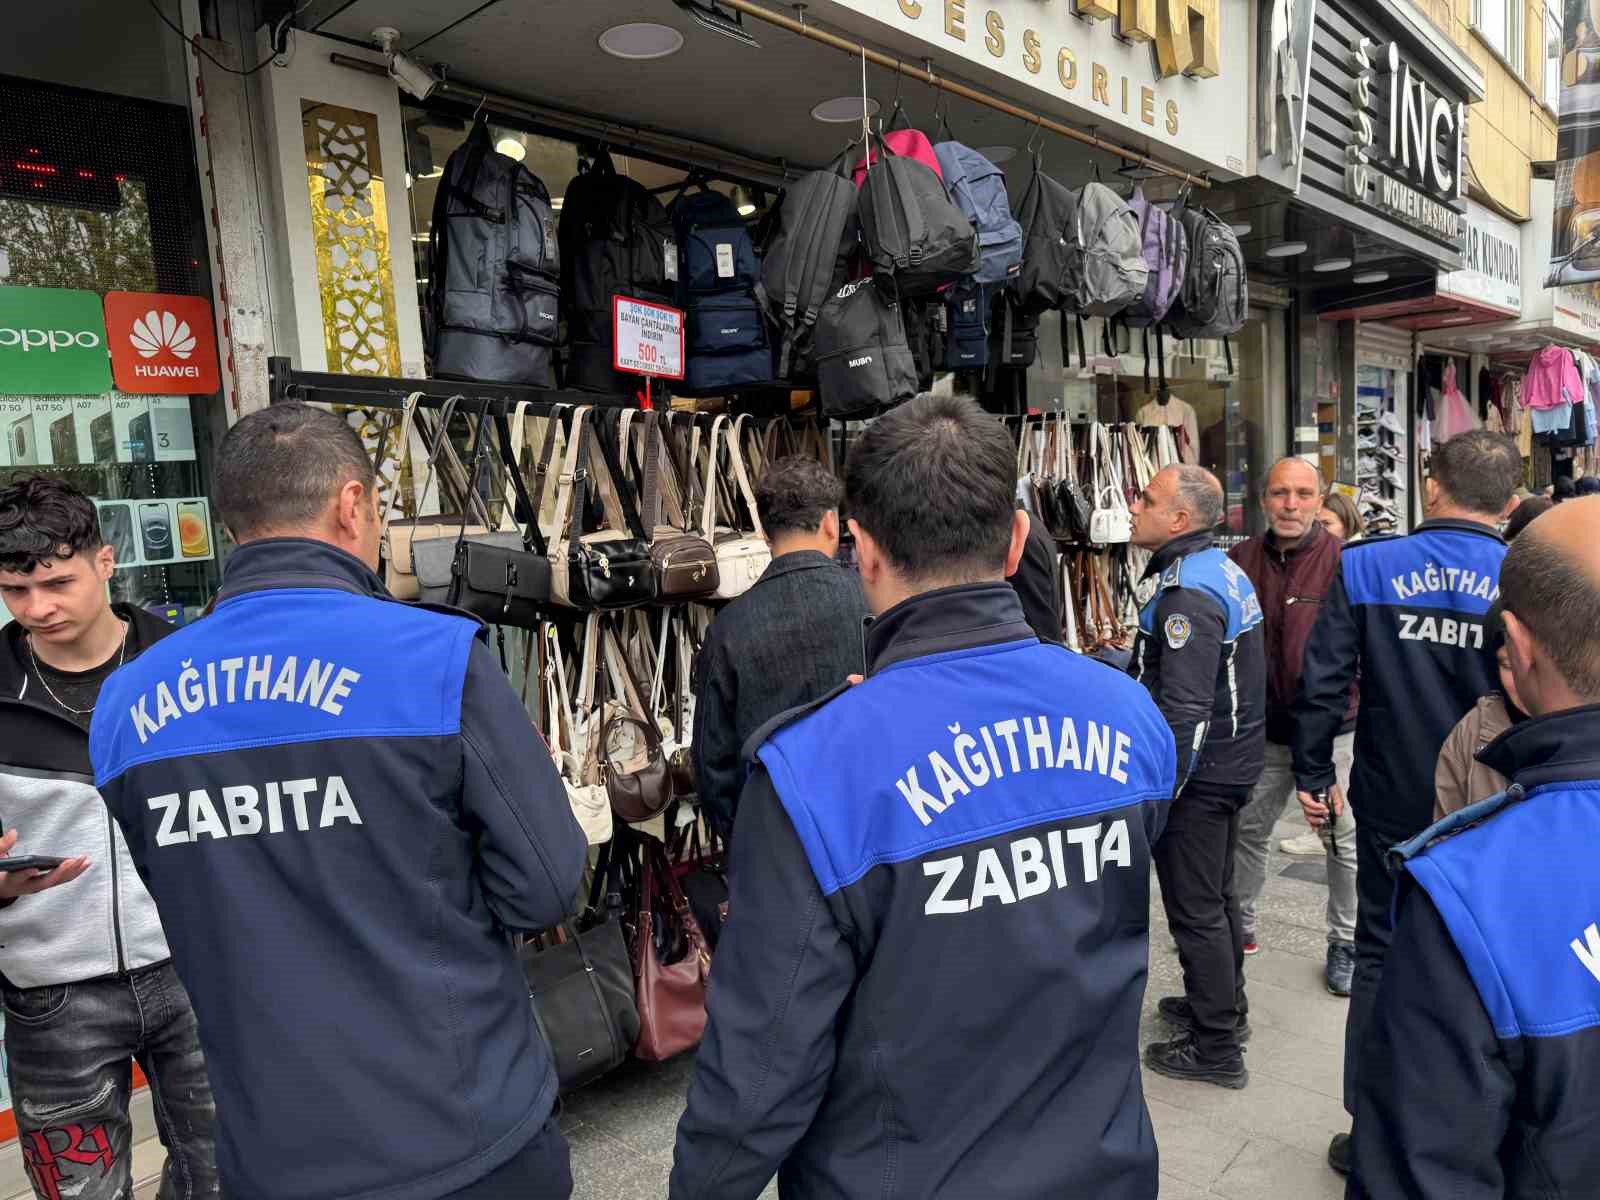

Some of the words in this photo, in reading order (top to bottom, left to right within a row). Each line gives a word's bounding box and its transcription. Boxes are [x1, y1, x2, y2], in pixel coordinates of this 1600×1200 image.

[1383, 174, 1421, 219] WOMEN
[1422, 194, 1458, 238] FASHION
[1464, 222, 1479, 272] AR
[1481, 230, 1520, 287] KUNDURA
[135, 365, 200, 378] HUAWEI
[639, 343, 657, 361] 500
[129, 654, 361, 744] KAĞITHANE
[896, 715, 1131, 826] KAĞITHANE
[147, 775, 363, 847] ZABITA
[922, 818, 1132, 916] ZABITA
